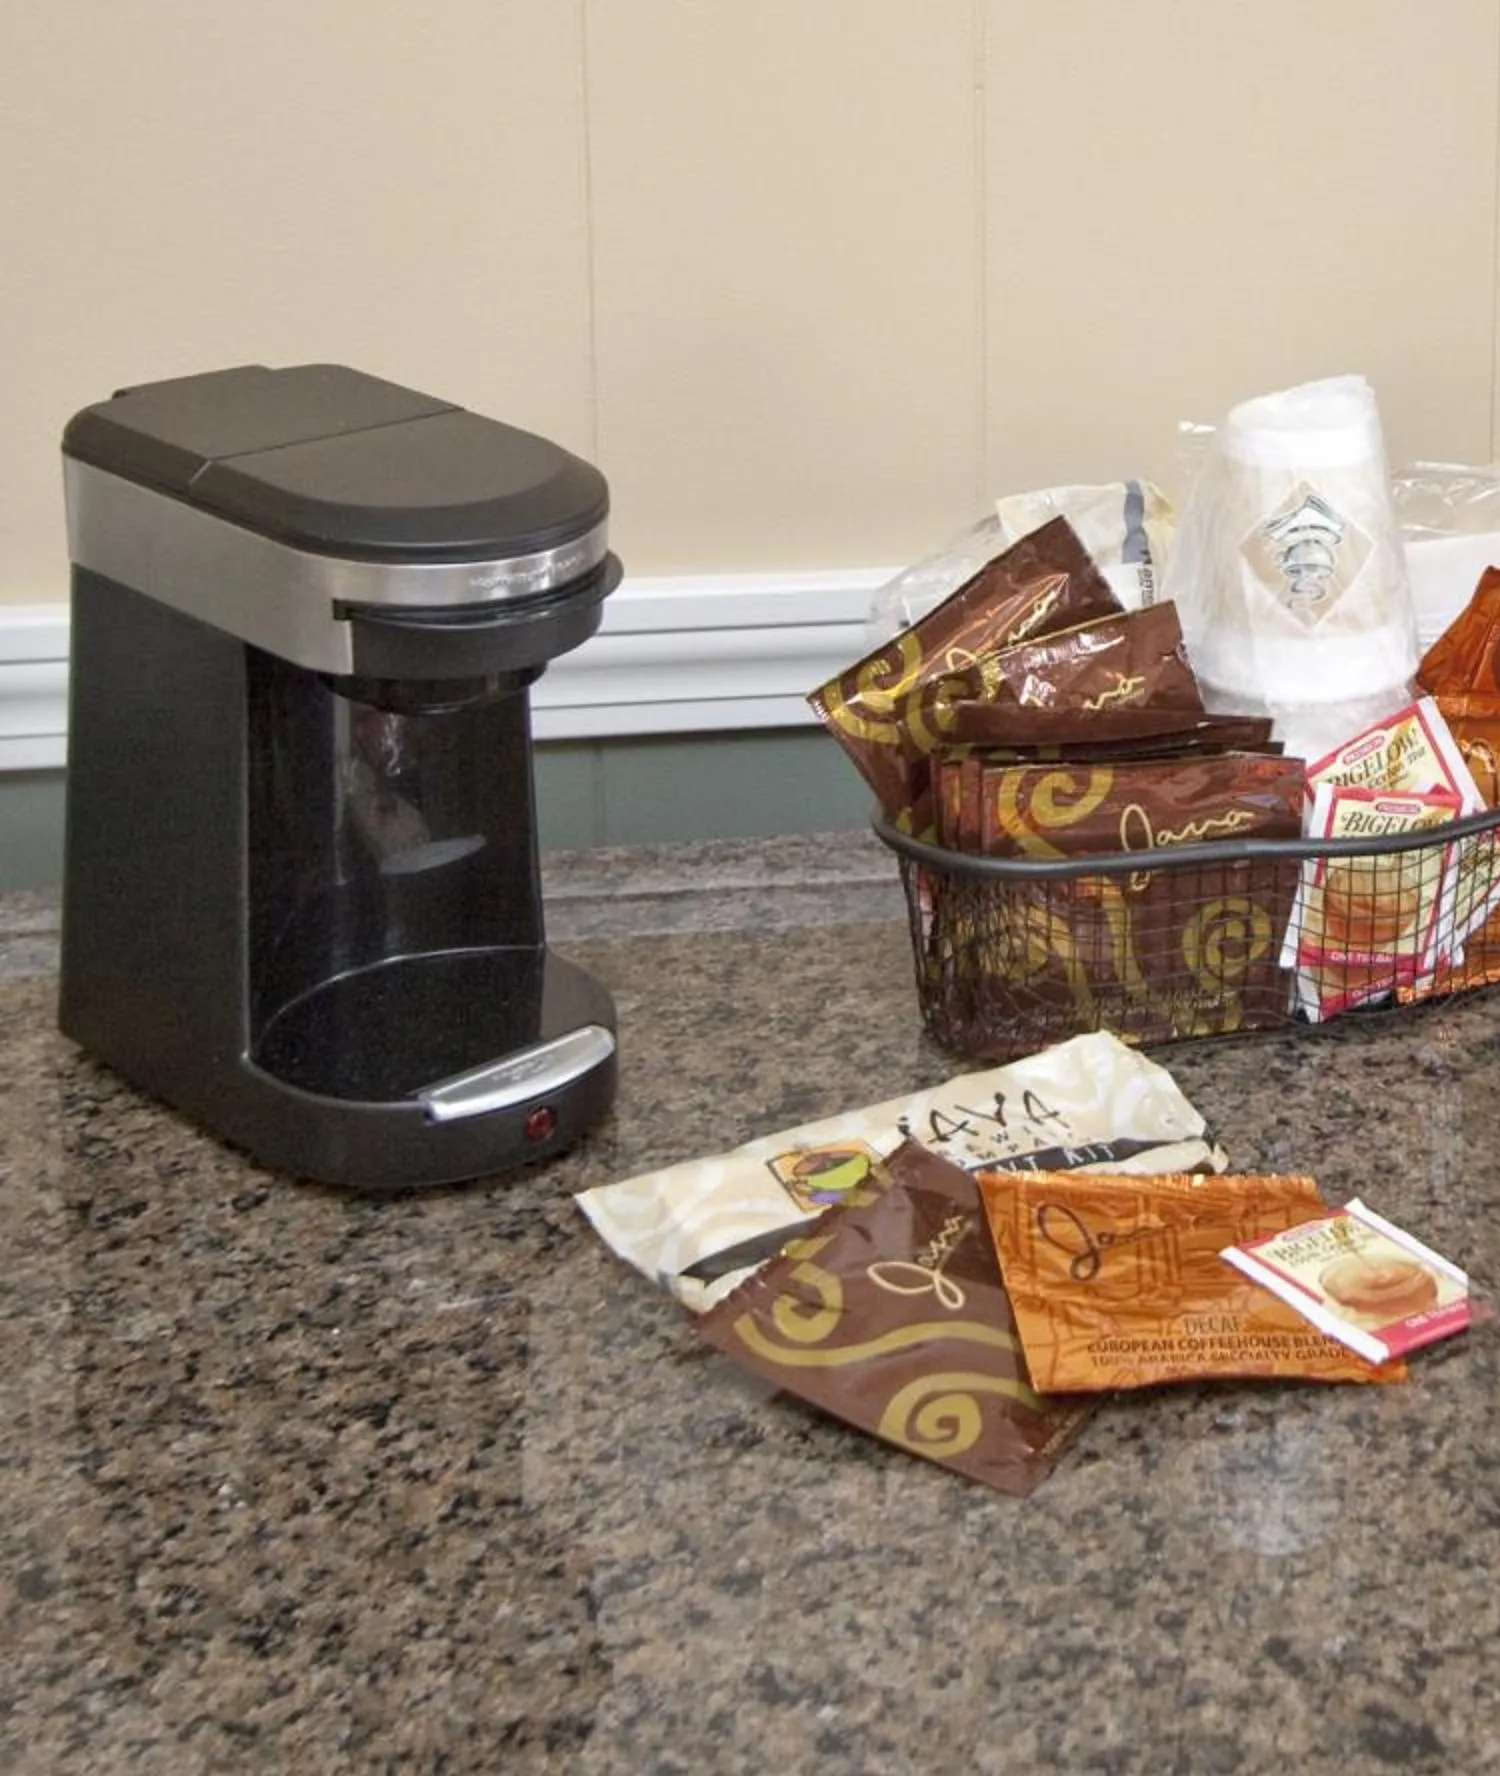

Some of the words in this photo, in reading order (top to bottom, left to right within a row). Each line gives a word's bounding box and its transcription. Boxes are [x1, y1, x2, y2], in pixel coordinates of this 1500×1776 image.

[1061, 1144, 1114, 1165] KIT
[1087, 1338, 1174, 1352] EUROPEAN
[1178, 1335, 1290, 1350] COFFEEHOUSE
[1293, 1334, 1341, 1347] BLEN
